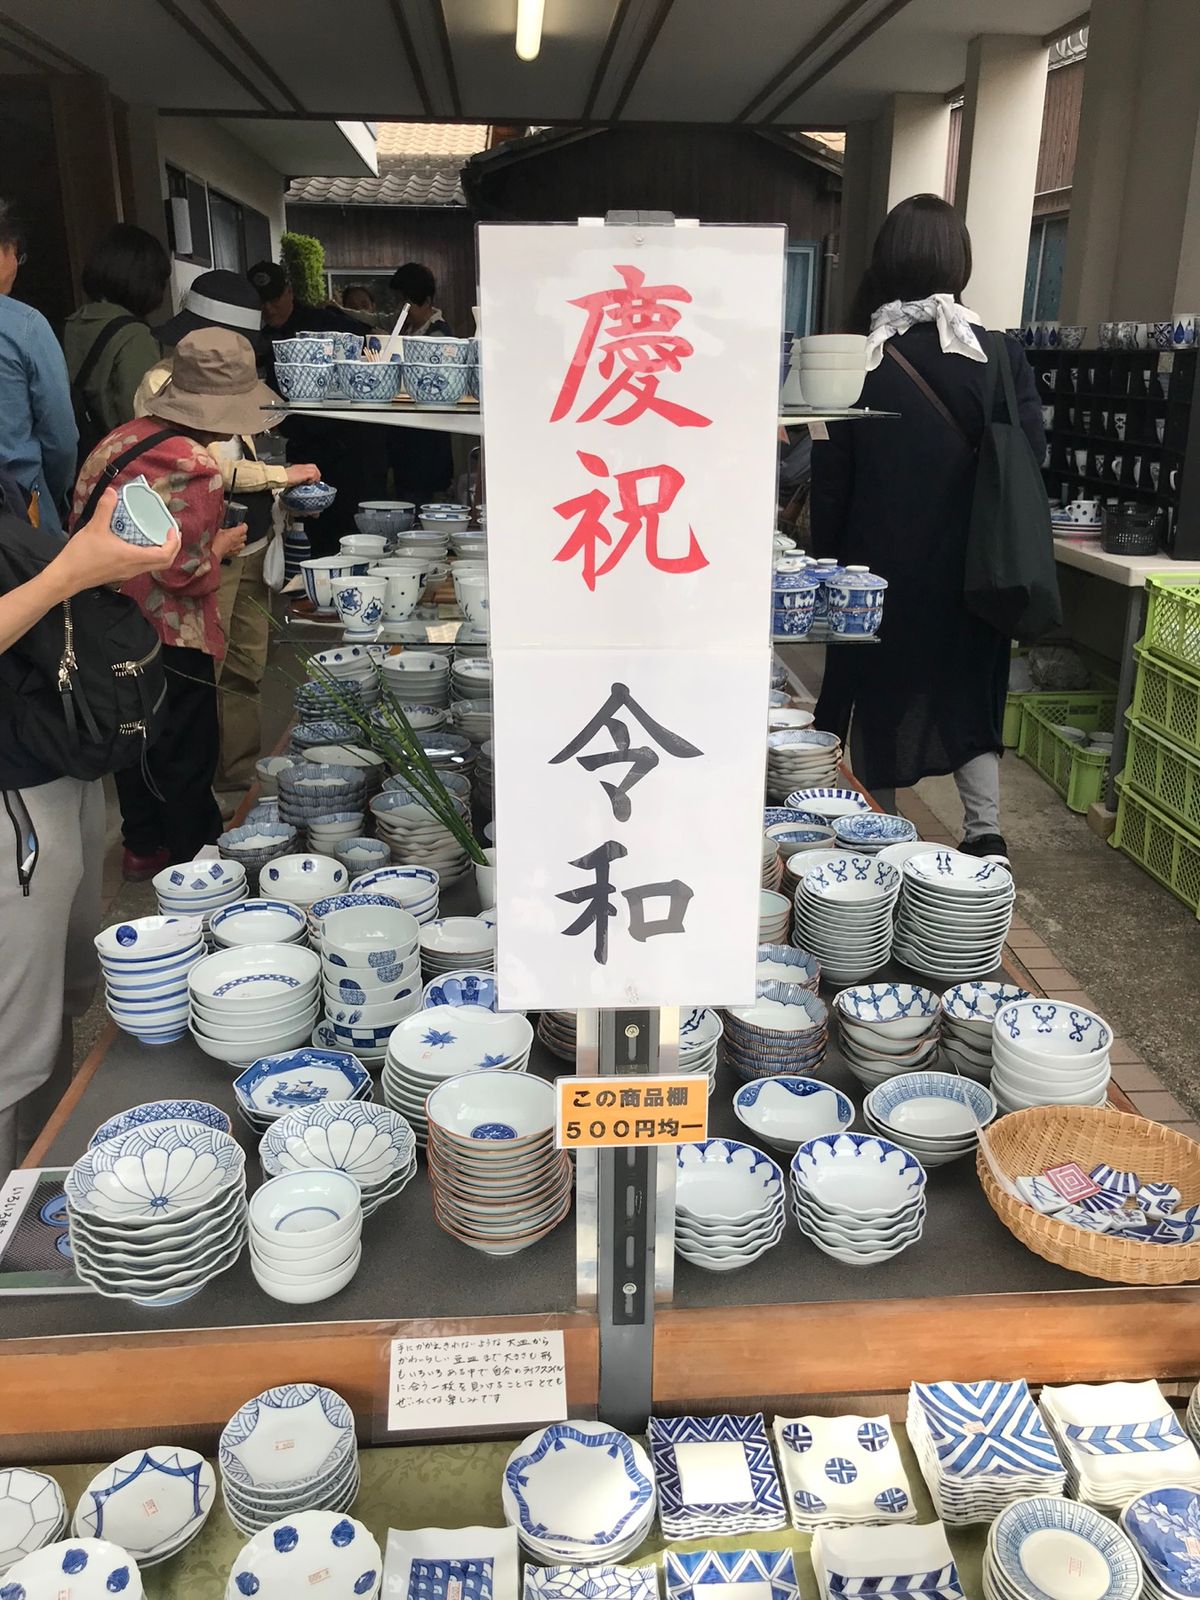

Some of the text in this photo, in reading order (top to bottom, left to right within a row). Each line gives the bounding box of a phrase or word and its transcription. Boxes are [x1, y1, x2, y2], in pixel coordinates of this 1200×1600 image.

[550, 265, 711, 592] 慶祝
[549, 682, 704, 965] 令和
[566, 1117, 704, 1140] 500円均一
[572, 1086, 689, 1108] この商品棚
